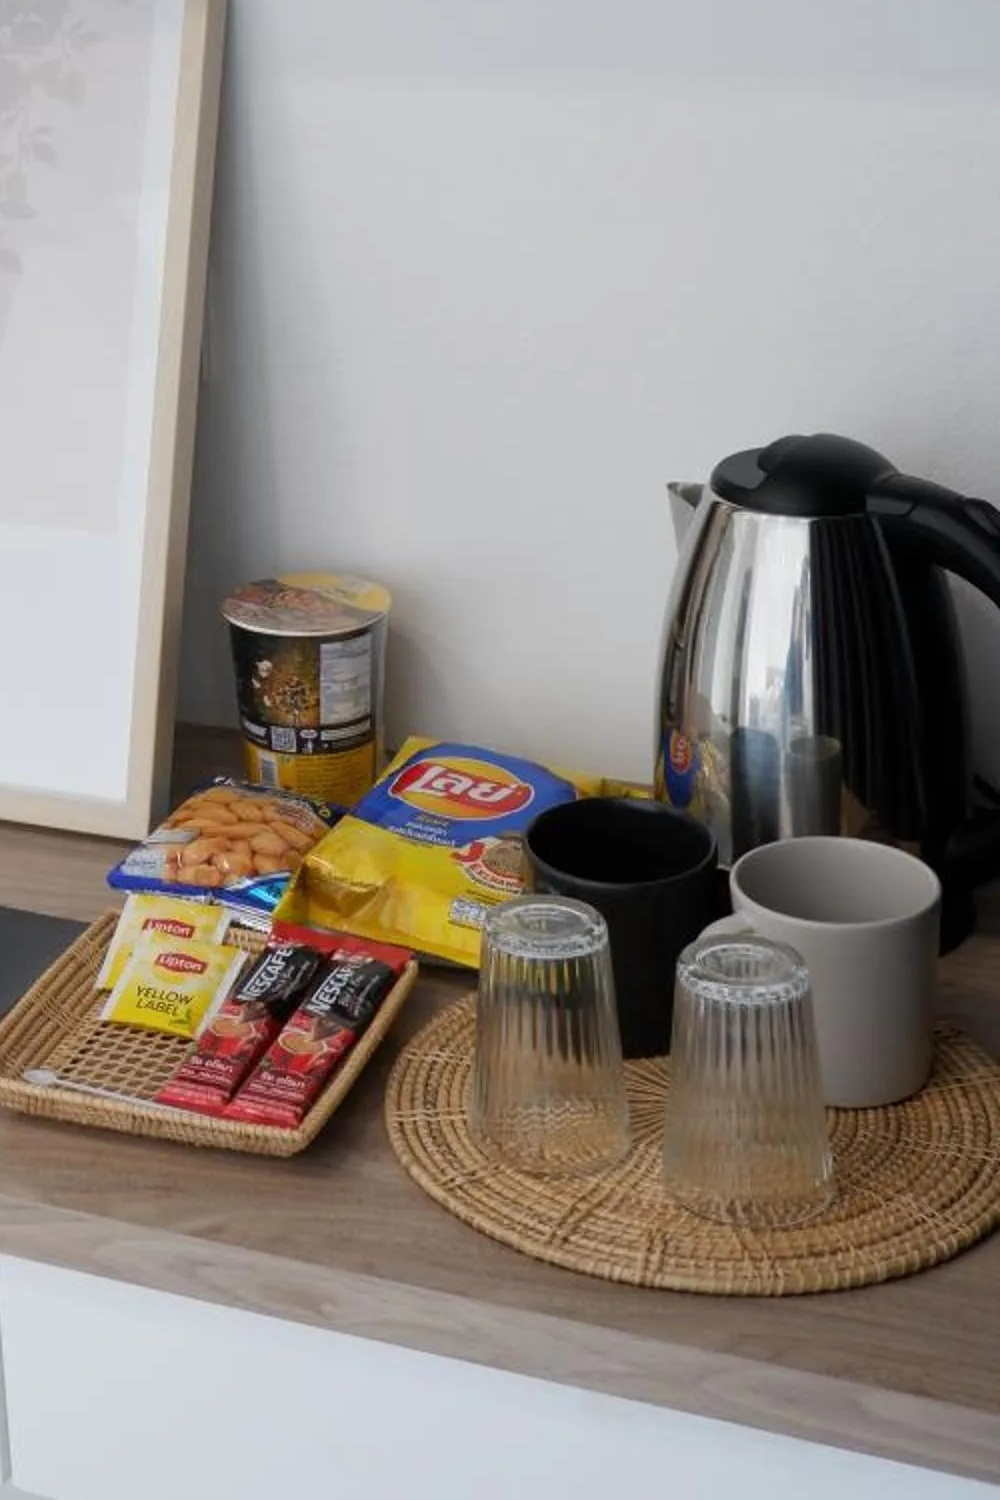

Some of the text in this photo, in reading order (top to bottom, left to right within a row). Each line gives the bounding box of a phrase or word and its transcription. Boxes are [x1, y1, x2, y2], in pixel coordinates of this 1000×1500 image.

[159, 955, 203, 974] Lipton
[136, 986, 193, 1004] YELLOW
[136, 998, 178, 1017] LABEL
